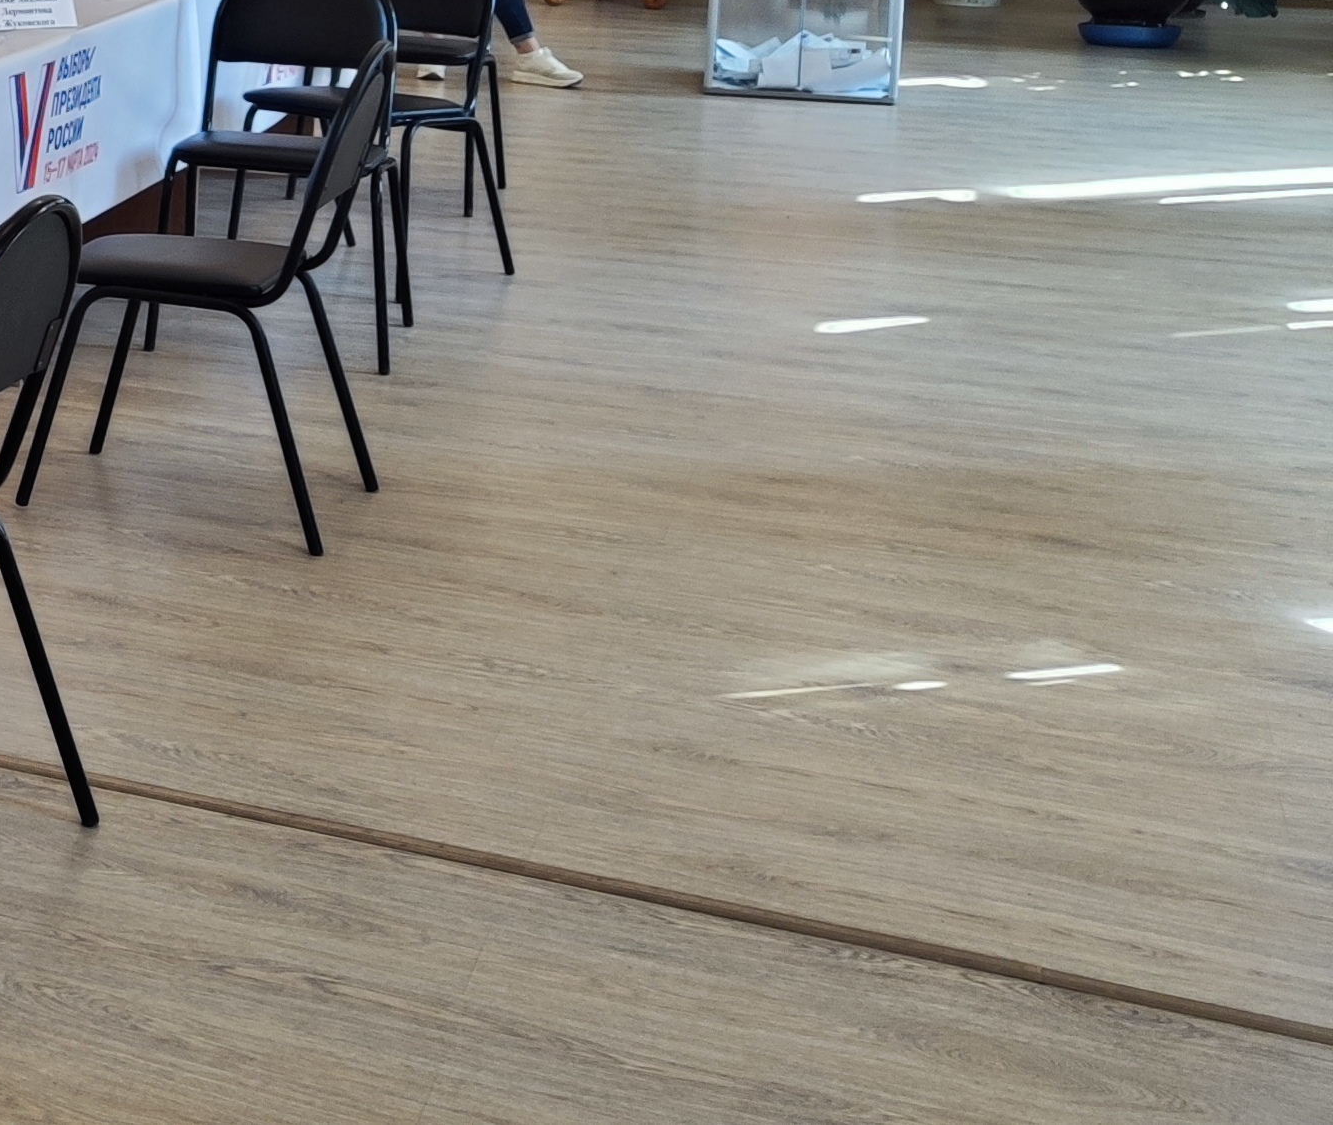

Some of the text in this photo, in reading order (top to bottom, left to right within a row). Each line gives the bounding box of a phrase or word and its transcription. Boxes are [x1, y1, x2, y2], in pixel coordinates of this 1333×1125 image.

[57, 46, 97, 82] ВЫБОРЫ
[51, 75, 101, 117] ПРЕЗИДЕНТА
[46, 116, 85, 153] РОССИИ
